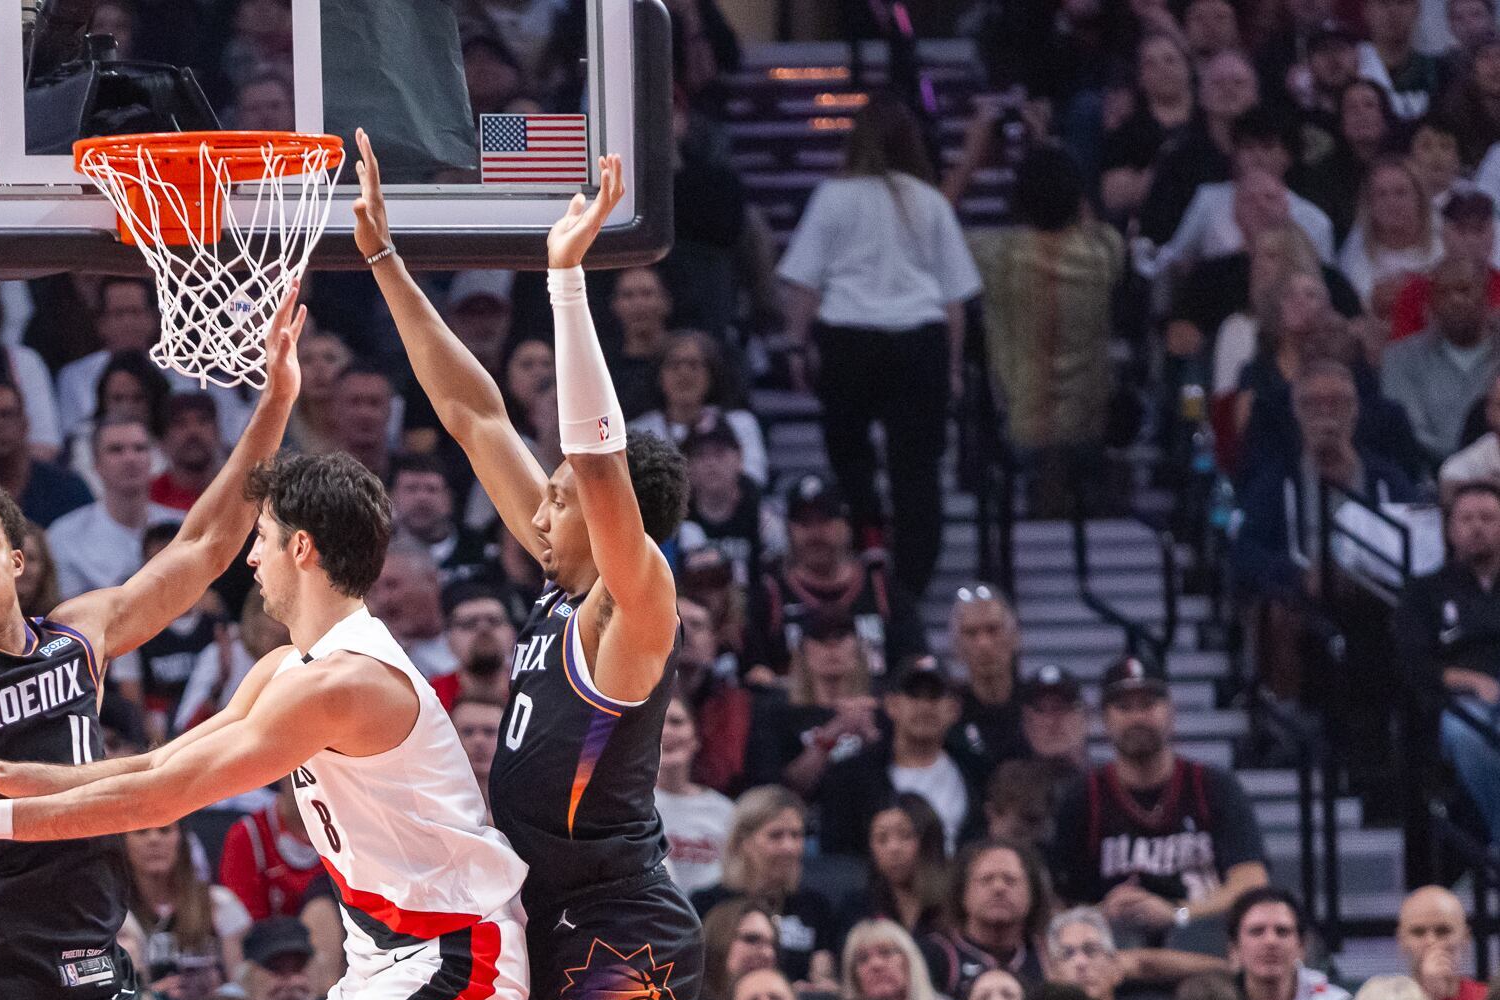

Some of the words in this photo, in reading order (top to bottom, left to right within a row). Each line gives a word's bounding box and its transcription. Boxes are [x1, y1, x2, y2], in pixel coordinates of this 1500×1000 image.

[555, 602, 573, 617] ze
[39, 636, 73, 657] paze
[68, 714, 93, 766] 11
[506, 691, 533, 751] 0
[311, 799, 341, 854] 8
